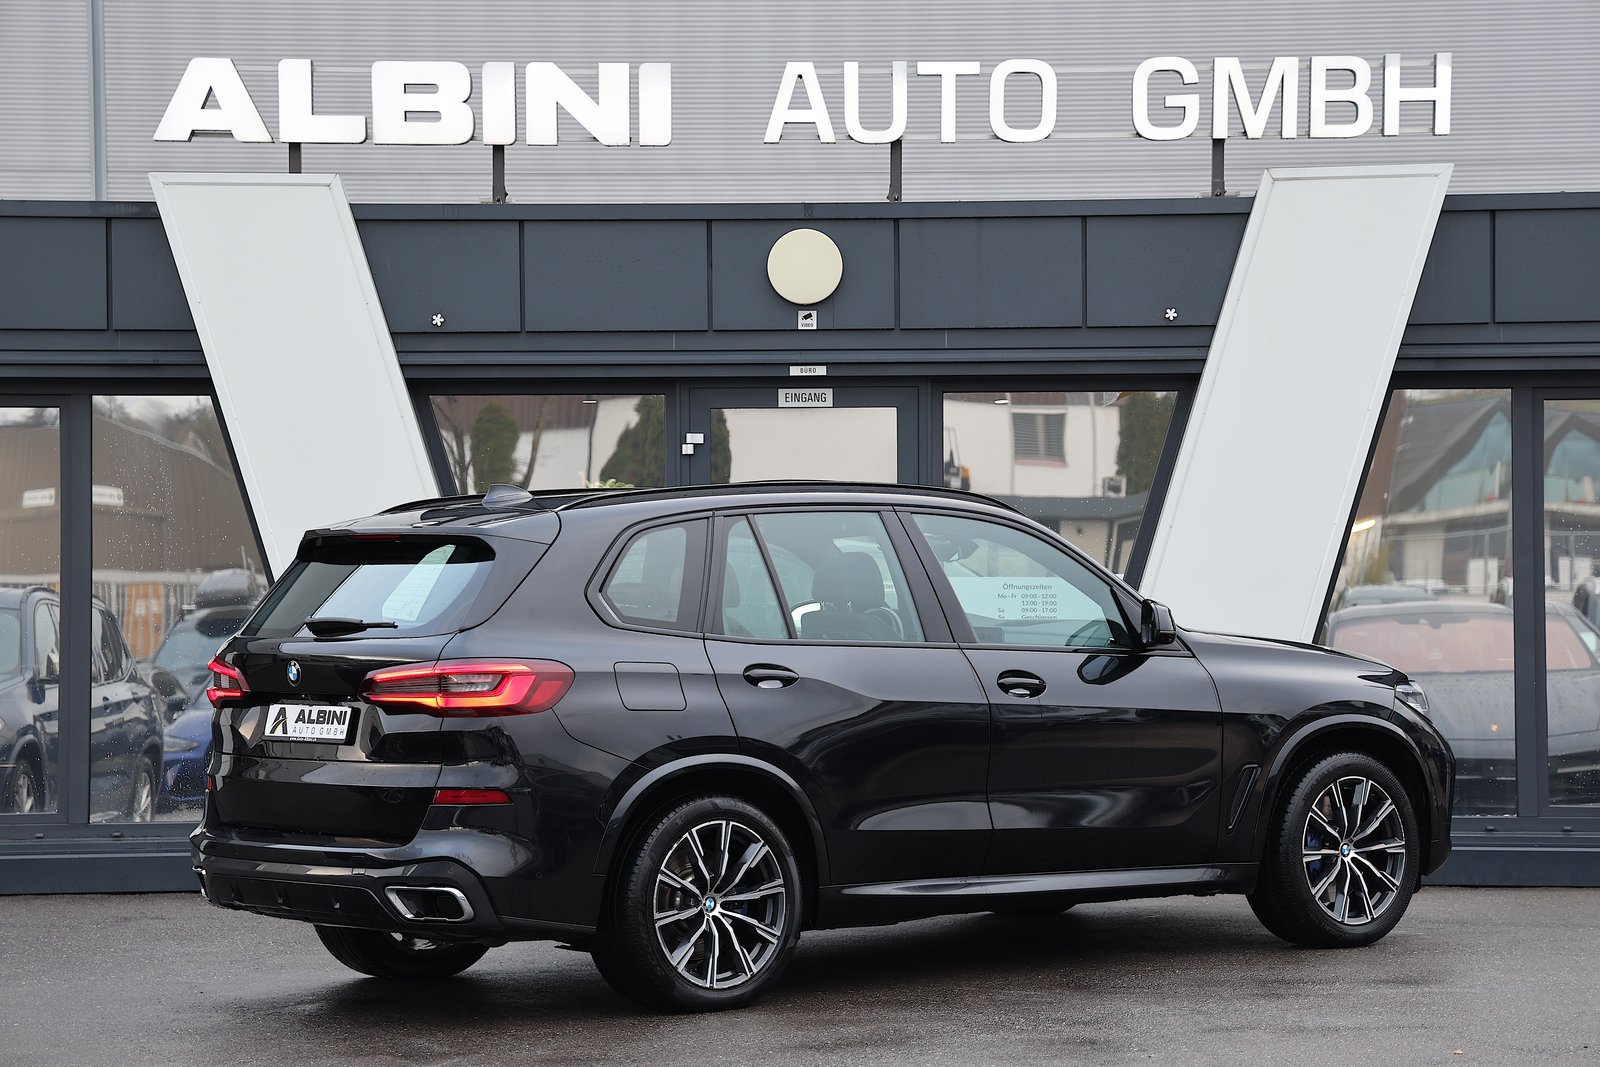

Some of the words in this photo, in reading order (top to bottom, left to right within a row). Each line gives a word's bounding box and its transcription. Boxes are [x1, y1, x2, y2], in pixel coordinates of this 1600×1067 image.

[152, 57, 674, 147] ALBINI
[763, 58, 1058, 145] AUTO
[1131, 52, 1453, 141] GMBH
[800, 366, 817, 374] BÜRO
[784, 392, 827, 403] EINGANG
[1002, 583, 1053, 591] Öffnungszeiten
[294, 708, 348, 726] ALBINI
[292, 726, 316, 735] AUTO
[319, 727, 345, 736] GMBH
